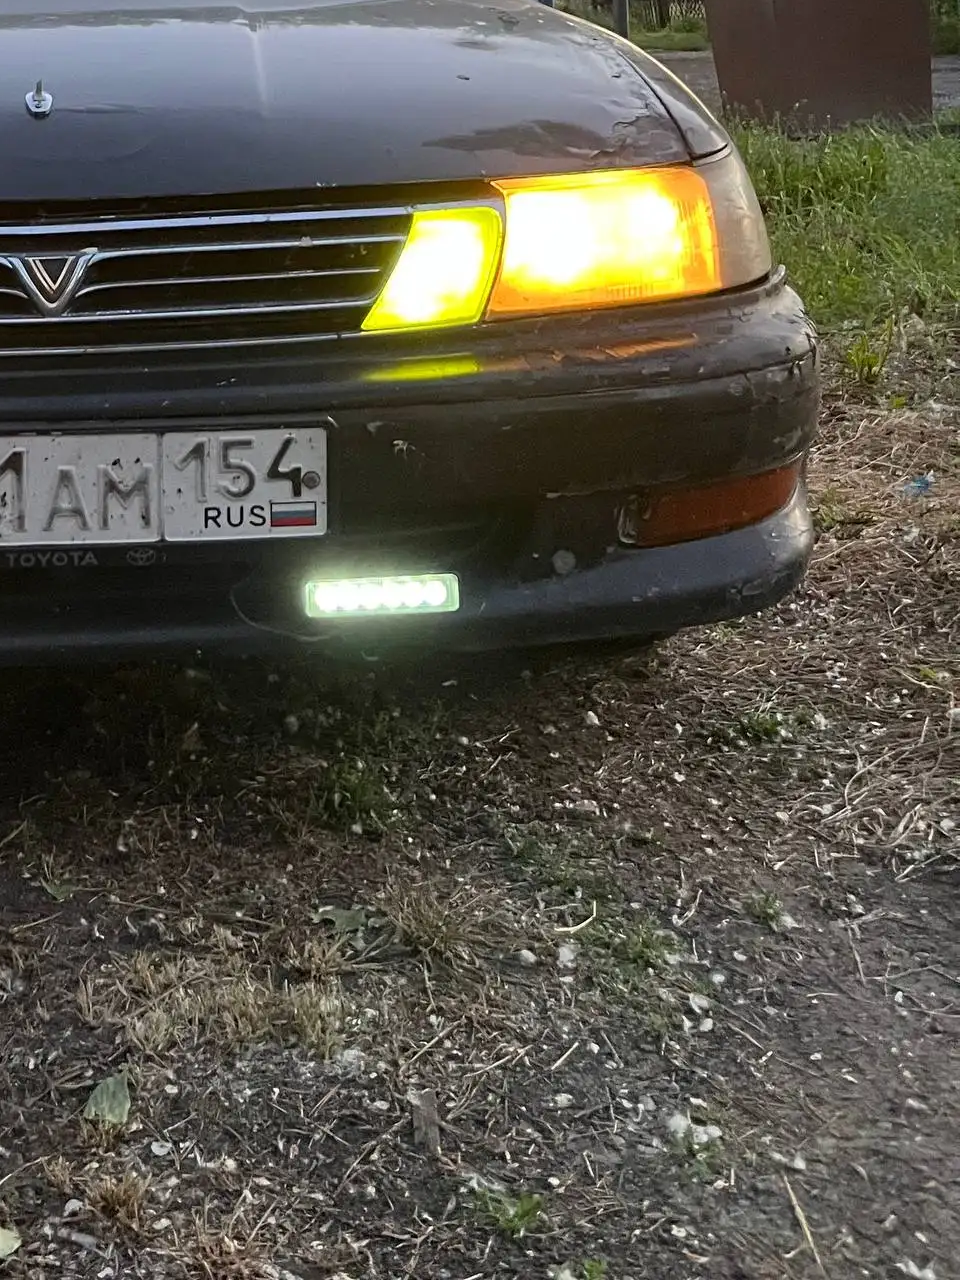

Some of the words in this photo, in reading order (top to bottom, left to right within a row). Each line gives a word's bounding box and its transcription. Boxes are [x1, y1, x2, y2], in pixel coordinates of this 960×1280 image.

[173, 434, 304, 503] 154
[204, 505, 267, 529] RUS
[6, 551, 99, 568] TOYOTA
